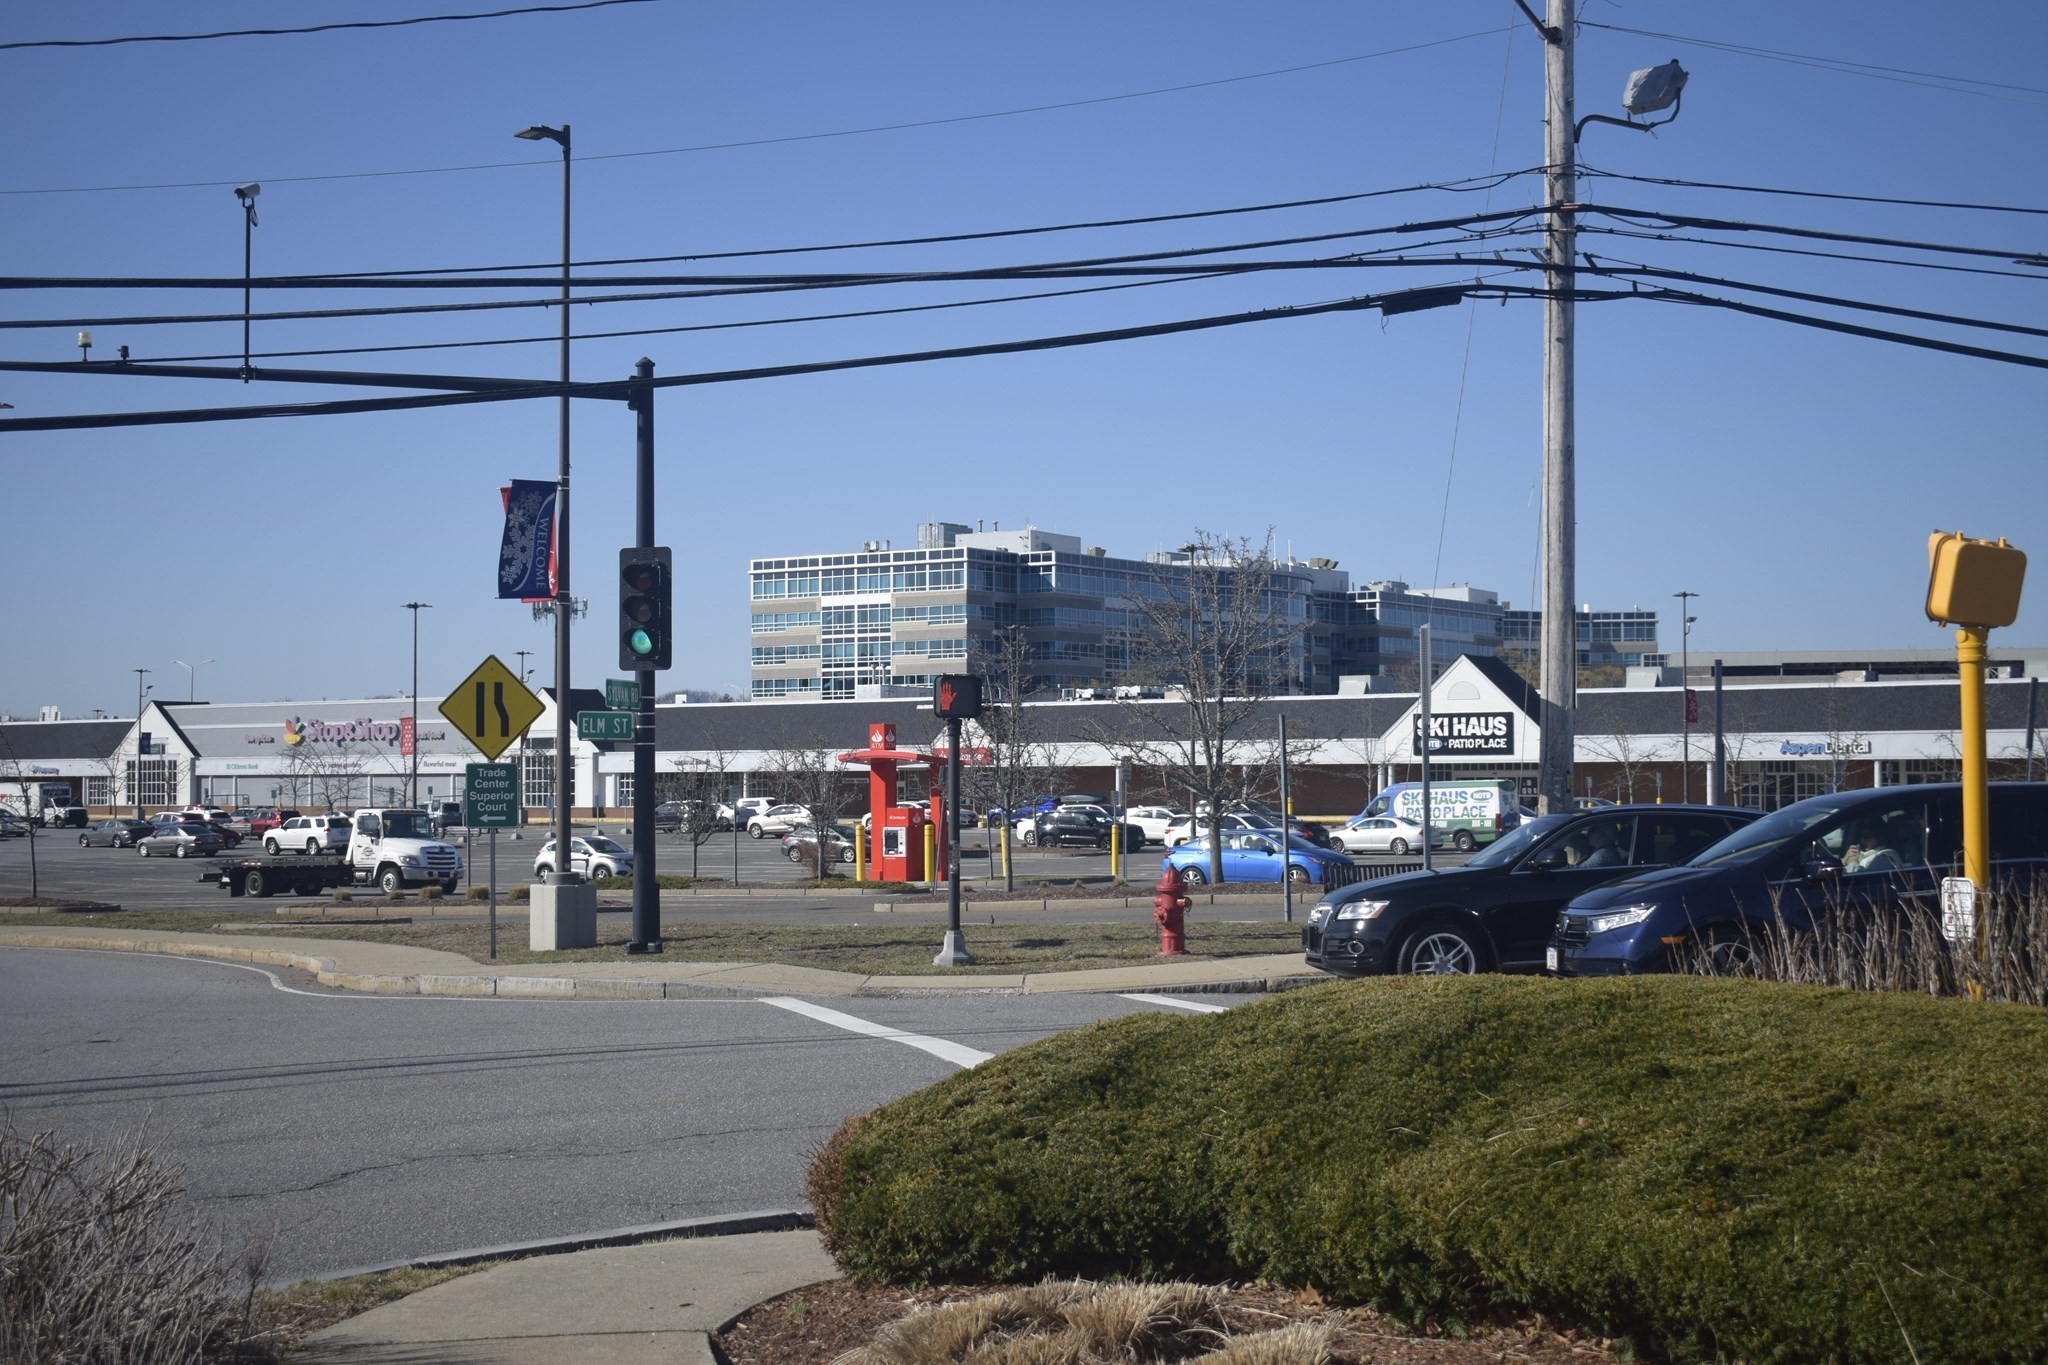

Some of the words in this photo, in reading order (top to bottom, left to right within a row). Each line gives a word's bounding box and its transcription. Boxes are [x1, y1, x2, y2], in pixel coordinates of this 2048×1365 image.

[536, 517, 550, 589] WELCOME
[608, 685, 629, 702] SYLVAN
[631, 687, 639, 703] RD
[582, 717, 605, 733] ELM
[613, 717, 628, 734] ST
[1453, 716, 1507, 736] HAUS
[1448, 738, 1475, 749] PATIO
[1475, 738, 1507, 749] PLACE
[477, 768, 507, 777] Trade
[474, 779, 510, 788] Center
[470, 791, 515, 802] Superior
[1429, 790, 1468, 805] HAUS
[477, 802, 507, 811] Court
[1443, 805, 1487, 818] PLACE
